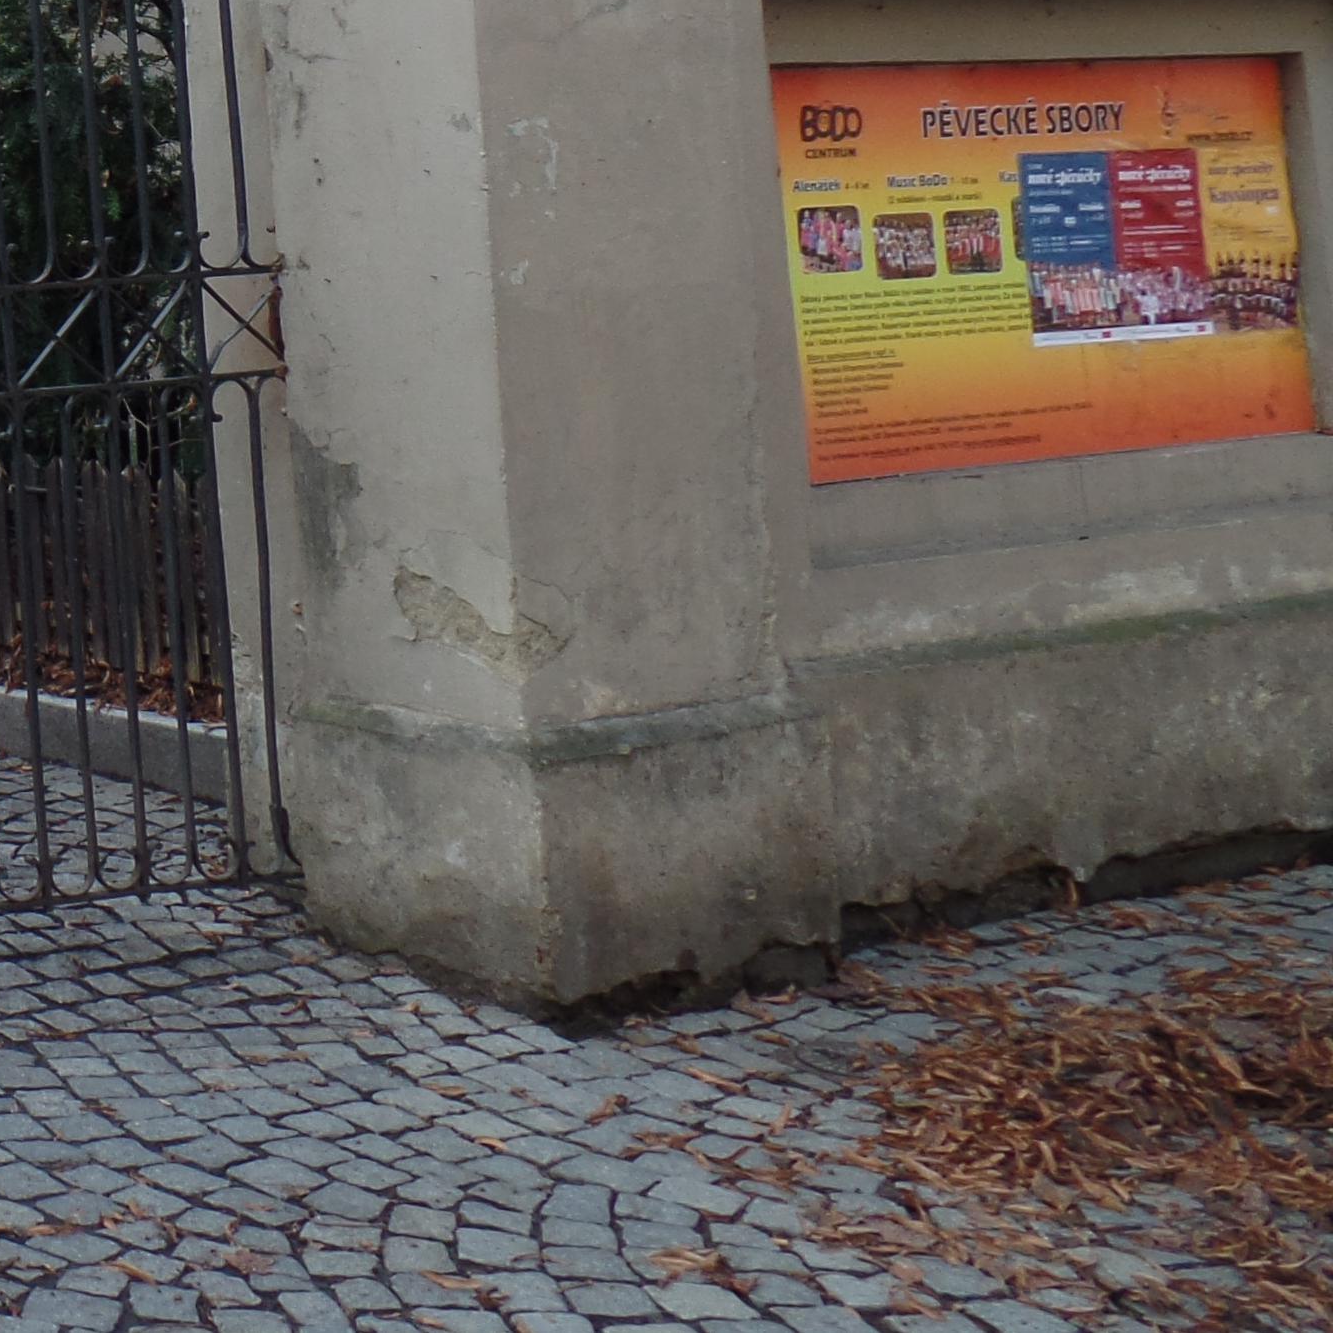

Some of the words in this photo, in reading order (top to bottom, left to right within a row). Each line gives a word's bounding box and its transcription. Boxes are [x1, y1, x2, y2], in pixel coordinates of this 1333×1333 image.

[921, 99, 1037, 138] PĚVECKÉ
[1045, 102, 1124, 134] SBORY
[805, 148, 857, 159] CENTRUM
